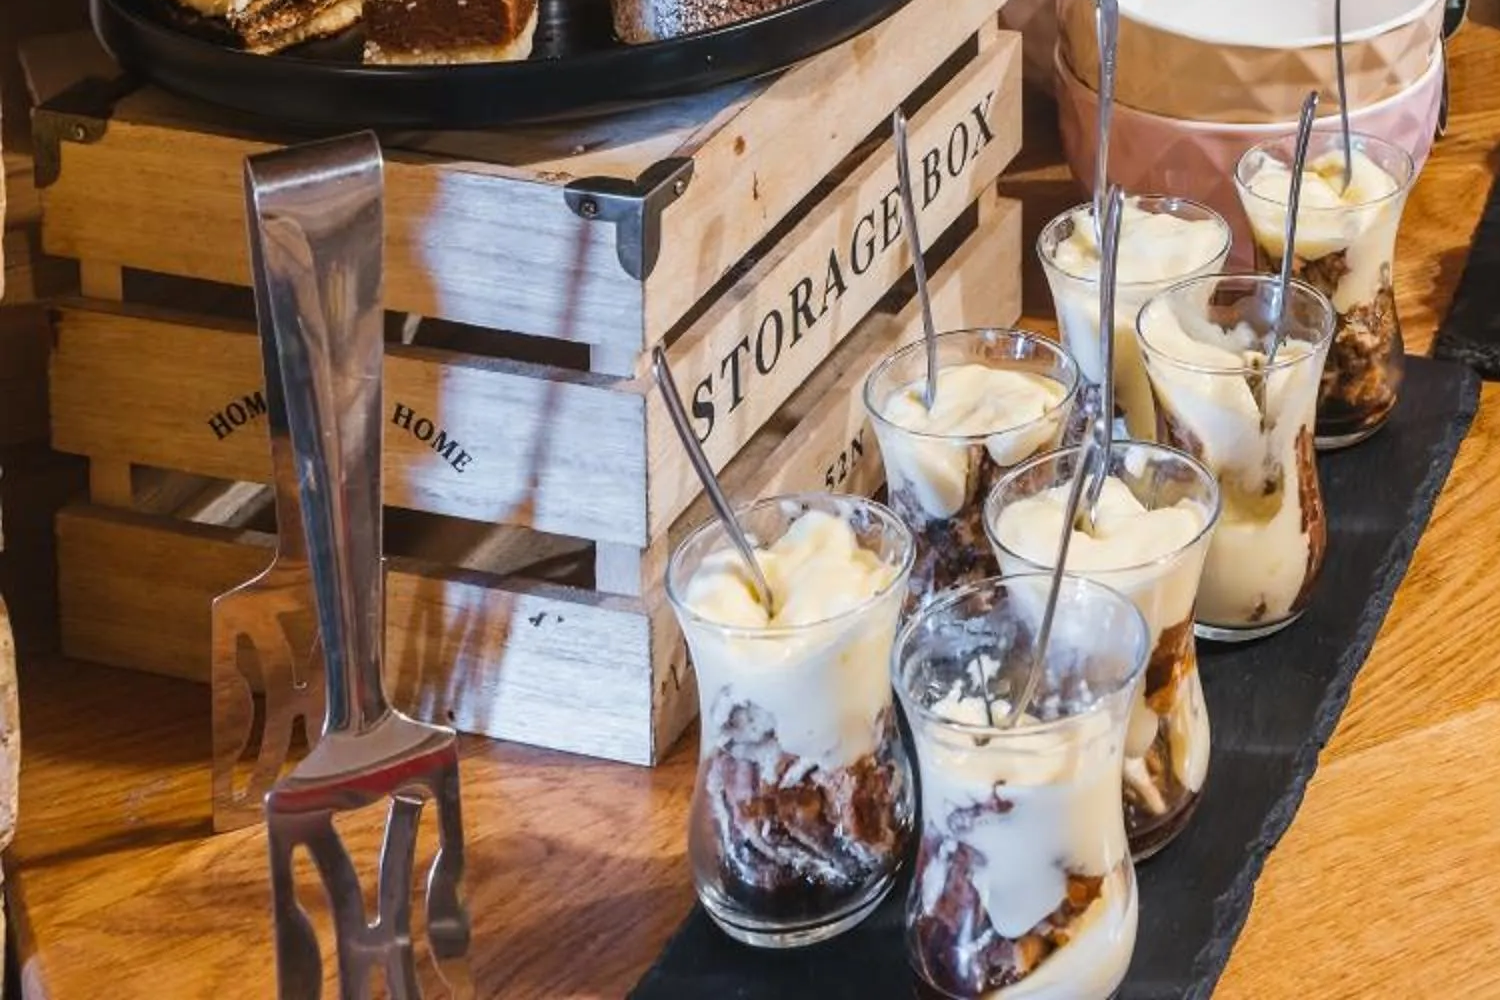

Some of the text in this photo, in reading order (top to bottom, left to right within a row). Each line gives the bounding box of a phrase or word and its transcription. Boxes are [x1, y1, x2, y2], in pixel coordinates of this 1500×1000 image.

[691, 90, 998, 444] STORAGE BOX
[207, 391, 267, 440] HOM
[392, 404, 473, 473] HOME
